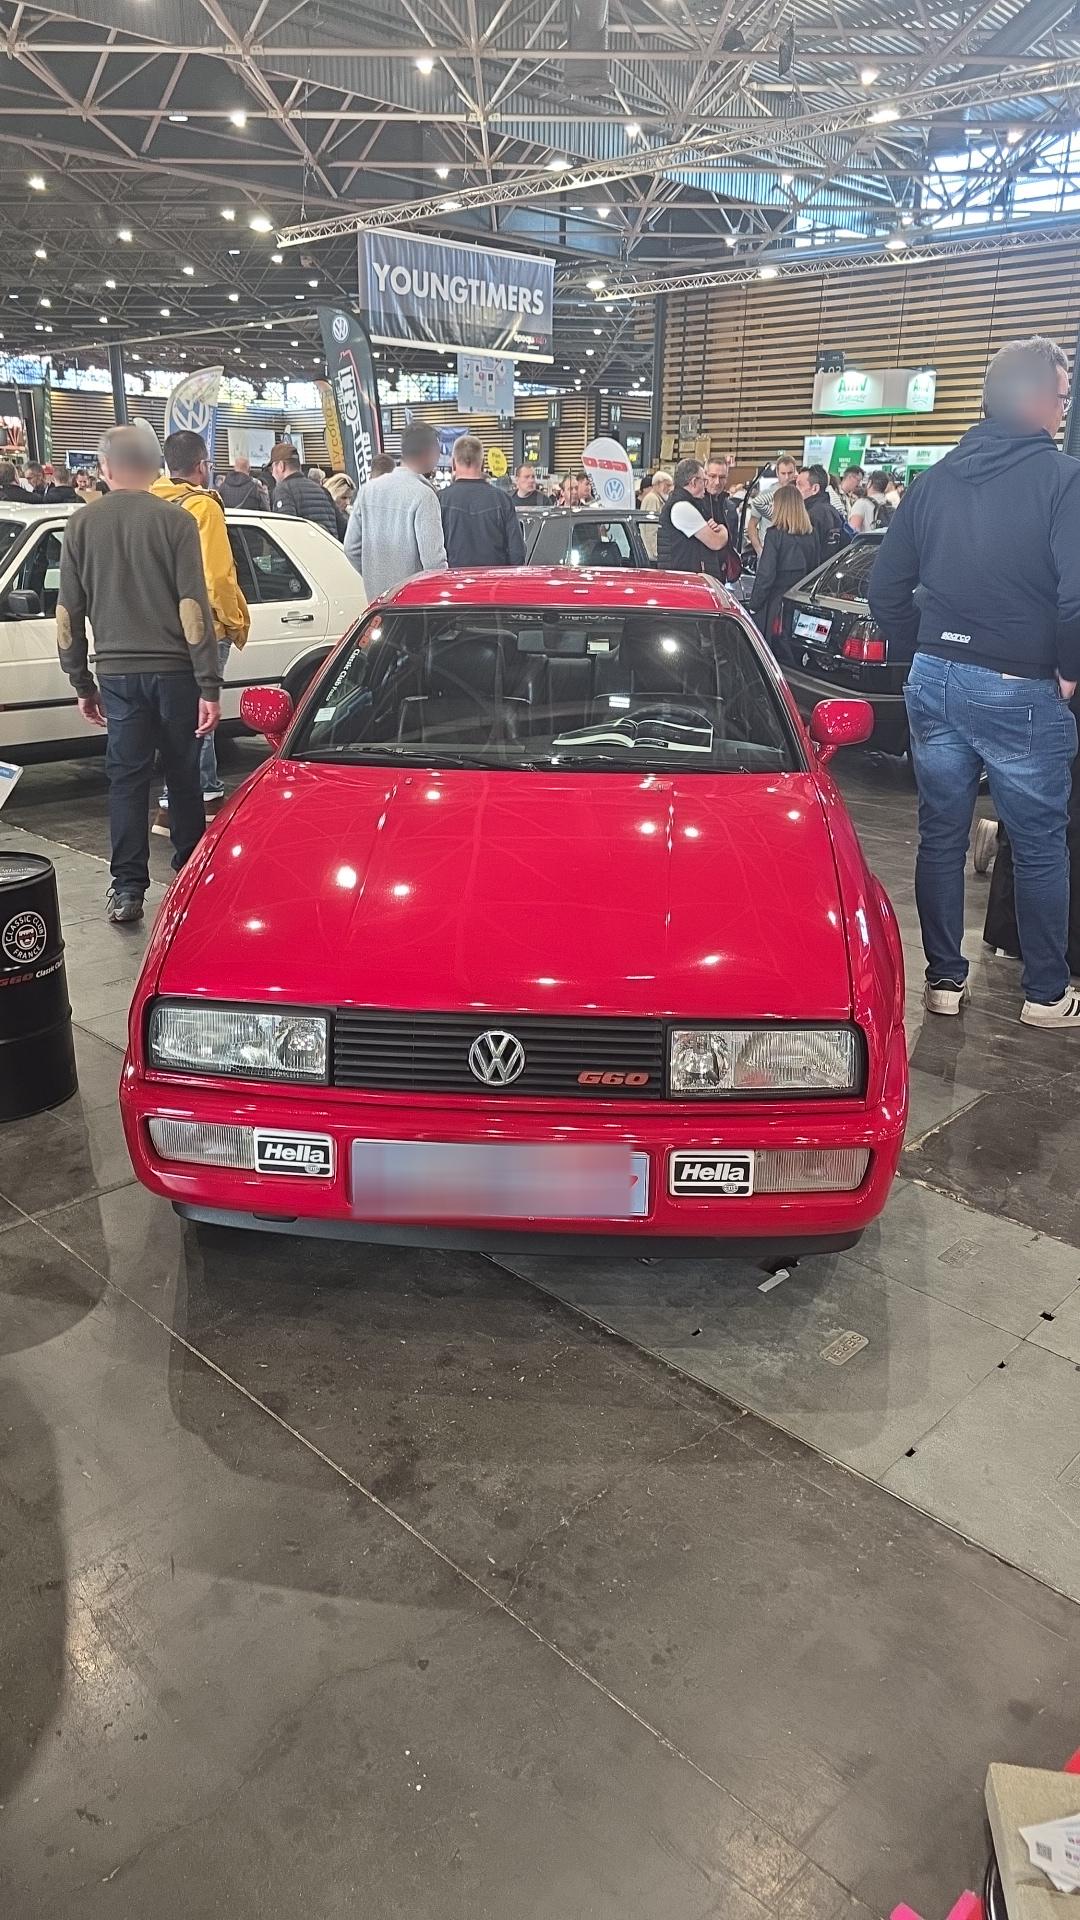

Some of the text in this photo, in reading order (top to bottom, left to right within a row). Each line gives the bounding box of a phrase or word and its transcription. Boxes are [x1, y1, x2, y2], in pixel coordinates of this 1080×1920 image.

[372, 262, 545, 315] YOUNGTIMERS
[941, 632, 972, 644] sparco
[344, 648, 360, 671] Classic
[335, 670, 347, 687] Club
[5, 915, 44, 942] CLASSIC CLUB
[13, 945, 41, 960] FRANCE
[36, 965, 54, 978] Classic
[577, 1071, 650, 1085] G60
[264, 1143, 324, 1163] Hella
[680, 1163, 745, 1181] Hella
